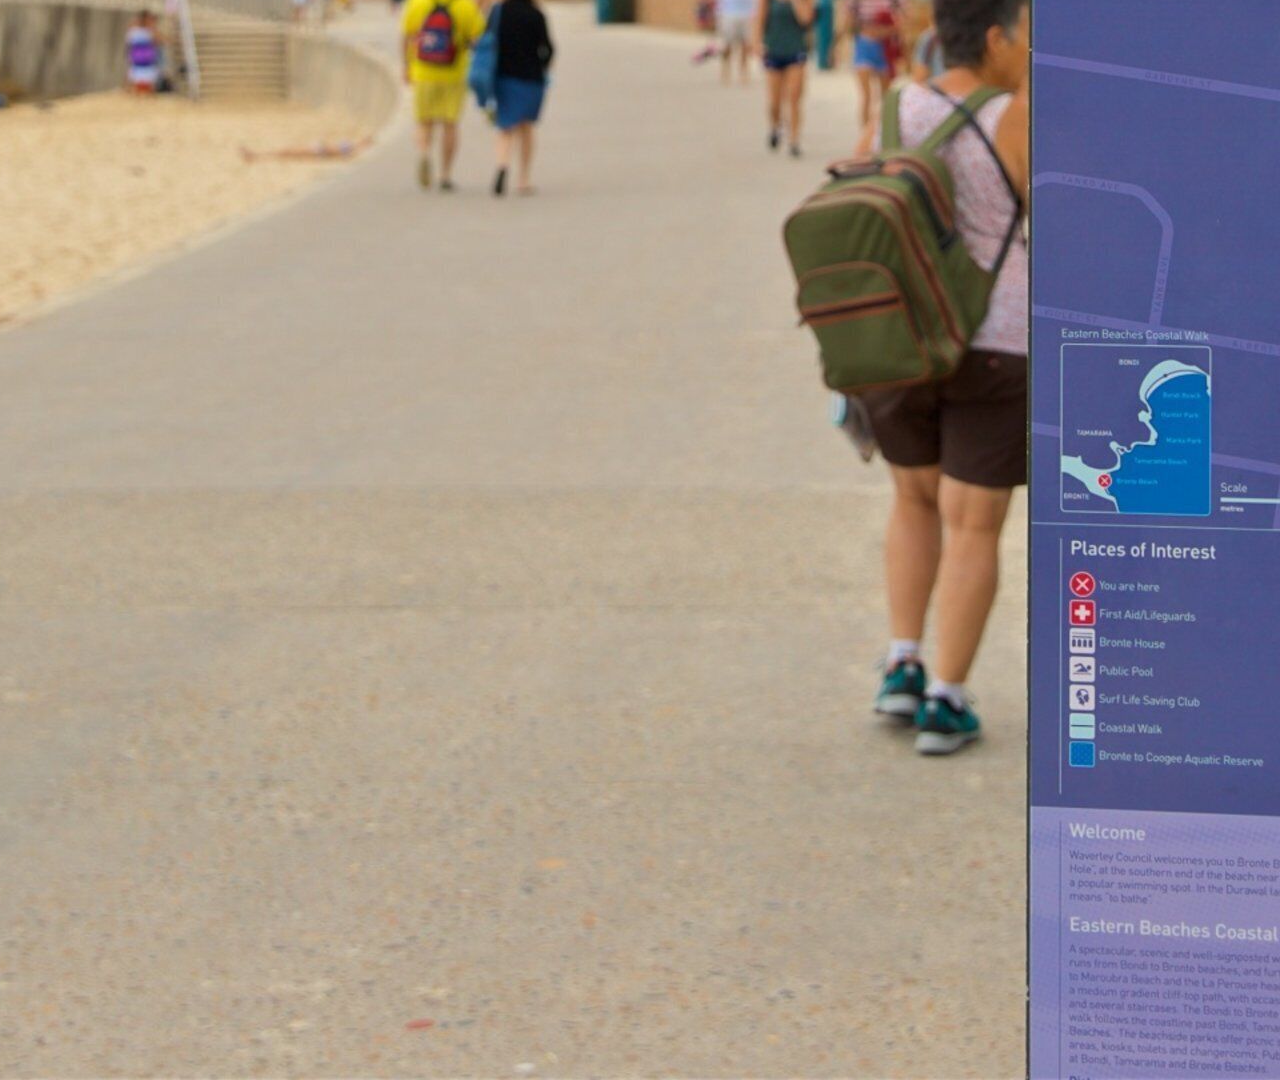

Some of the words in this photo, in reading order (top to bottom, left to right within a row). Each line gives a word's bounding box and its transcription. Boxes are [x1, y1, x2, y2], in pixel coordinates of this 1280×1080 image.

[1061, 328, 1099, 339] Eastern
[1101, 329, 1143, 339] Beaches
[1145, 330, 1182, 340] Coastal
[1184, 331, 1209, 341] Walk
[1220, 483, 1248, 493] Scale
[1071, 541, 1126, 557] Places
[1130, 542, 1146, 557] of
[1152, 543, 1216, 560] Interest
[1099, 581, 1116, 591] You
[1137, 582, 1160, 593] here
[1099, 609, 1122, 619] First
[1124, 610, 1196, 624] Aid/Lifeguards
[1099, 637, 1132, 648] Bronte
[1134, 639, 1166, 649] House
[1099, 665, 1129, 676] Public
[1131, 666, 1153, 677] Pool
[1099, 694, 1120, 704] Surf
[1122, 695, 1141, 705] Life
[1143, 695, 1175, 709] Saving
[1177, 697, 1200, 707] Club
[1099, 722, 1136, 733] Coastal
[1137, 724, 1162, 734] Walk
[1099, 750, 1132, 762] Bronte
[1134, 753, 1144, 762] to
[1146, 752, 1182, 766] Coogee
[1184, 754, 1221, 766] Aquatic
[1223, 755, 1264, 767] Reserve
[1069, 824, 1146, 841] Welcome
[1069, 850, 1114, 864] Waverley
[1115, 852, 1152, 863] Council
[1154, 855, 1204, 866] welcomes
[1205, 858, 1223, 868] you
[1225, 859, 1235, 867] to
[1237, 857, 1271, 869] Bronte
[1070, 917, 1134, 934] Eastern
[1140, 920, 1210, 938] Beaches
[1215, 924, 1278, 941] Coastal
